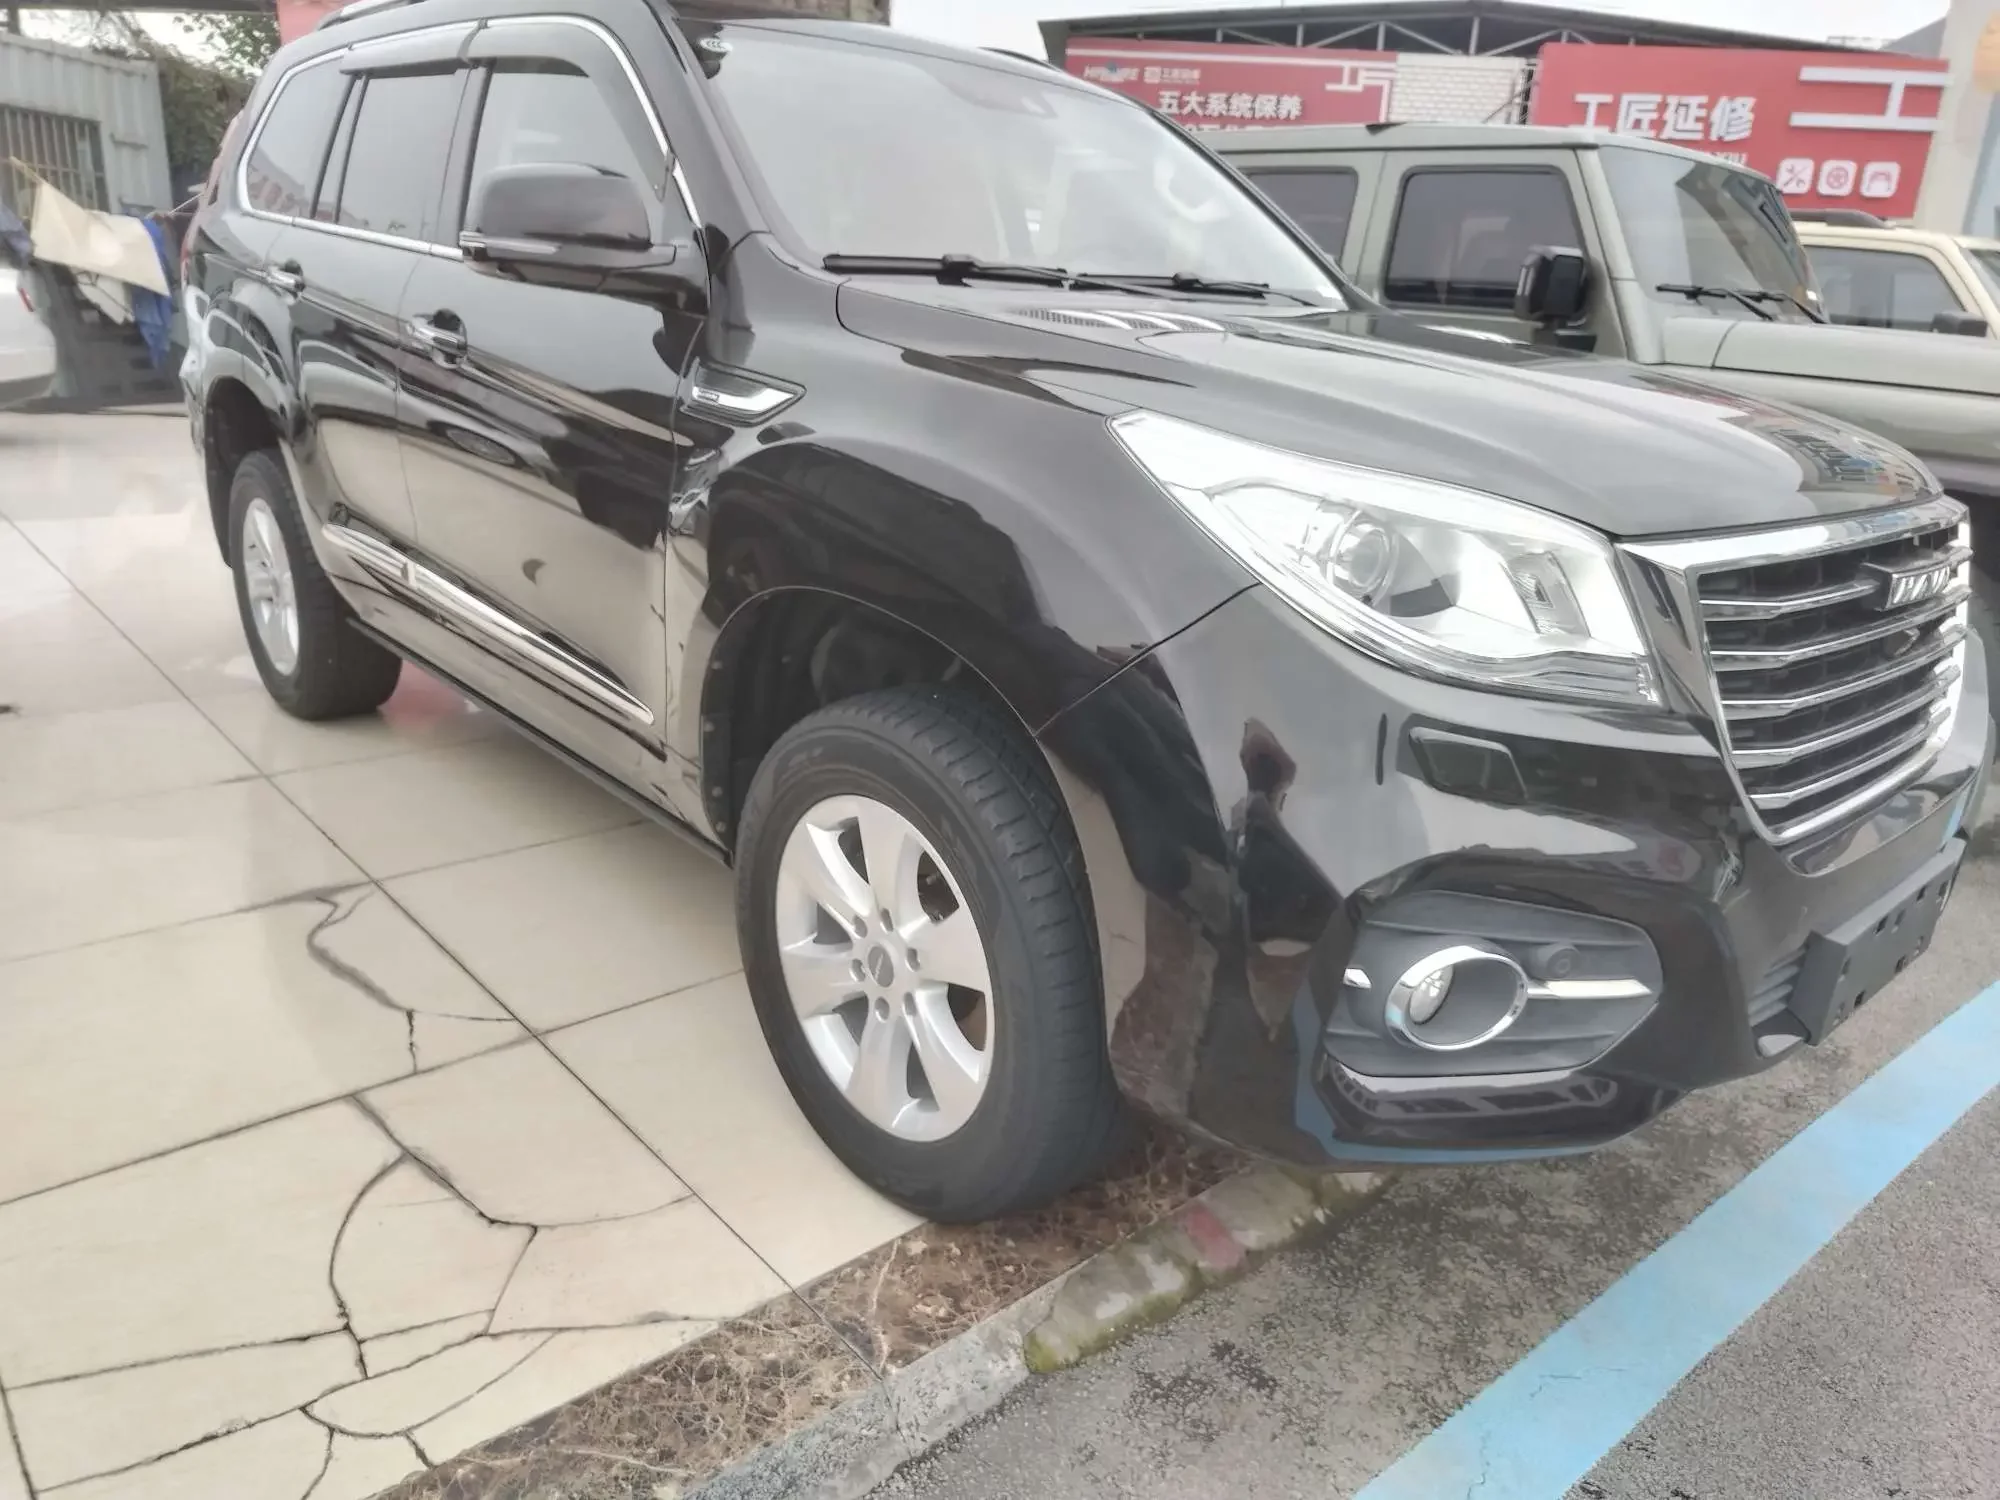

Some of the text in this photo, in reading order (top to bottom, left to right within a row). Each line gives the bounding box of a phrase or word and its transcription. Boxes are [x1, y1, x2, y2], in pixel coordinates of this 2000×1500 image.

[1158, 90, 1302, 120] 五大系统保养
[1568, 92, 1757, 142] 工匠延修
